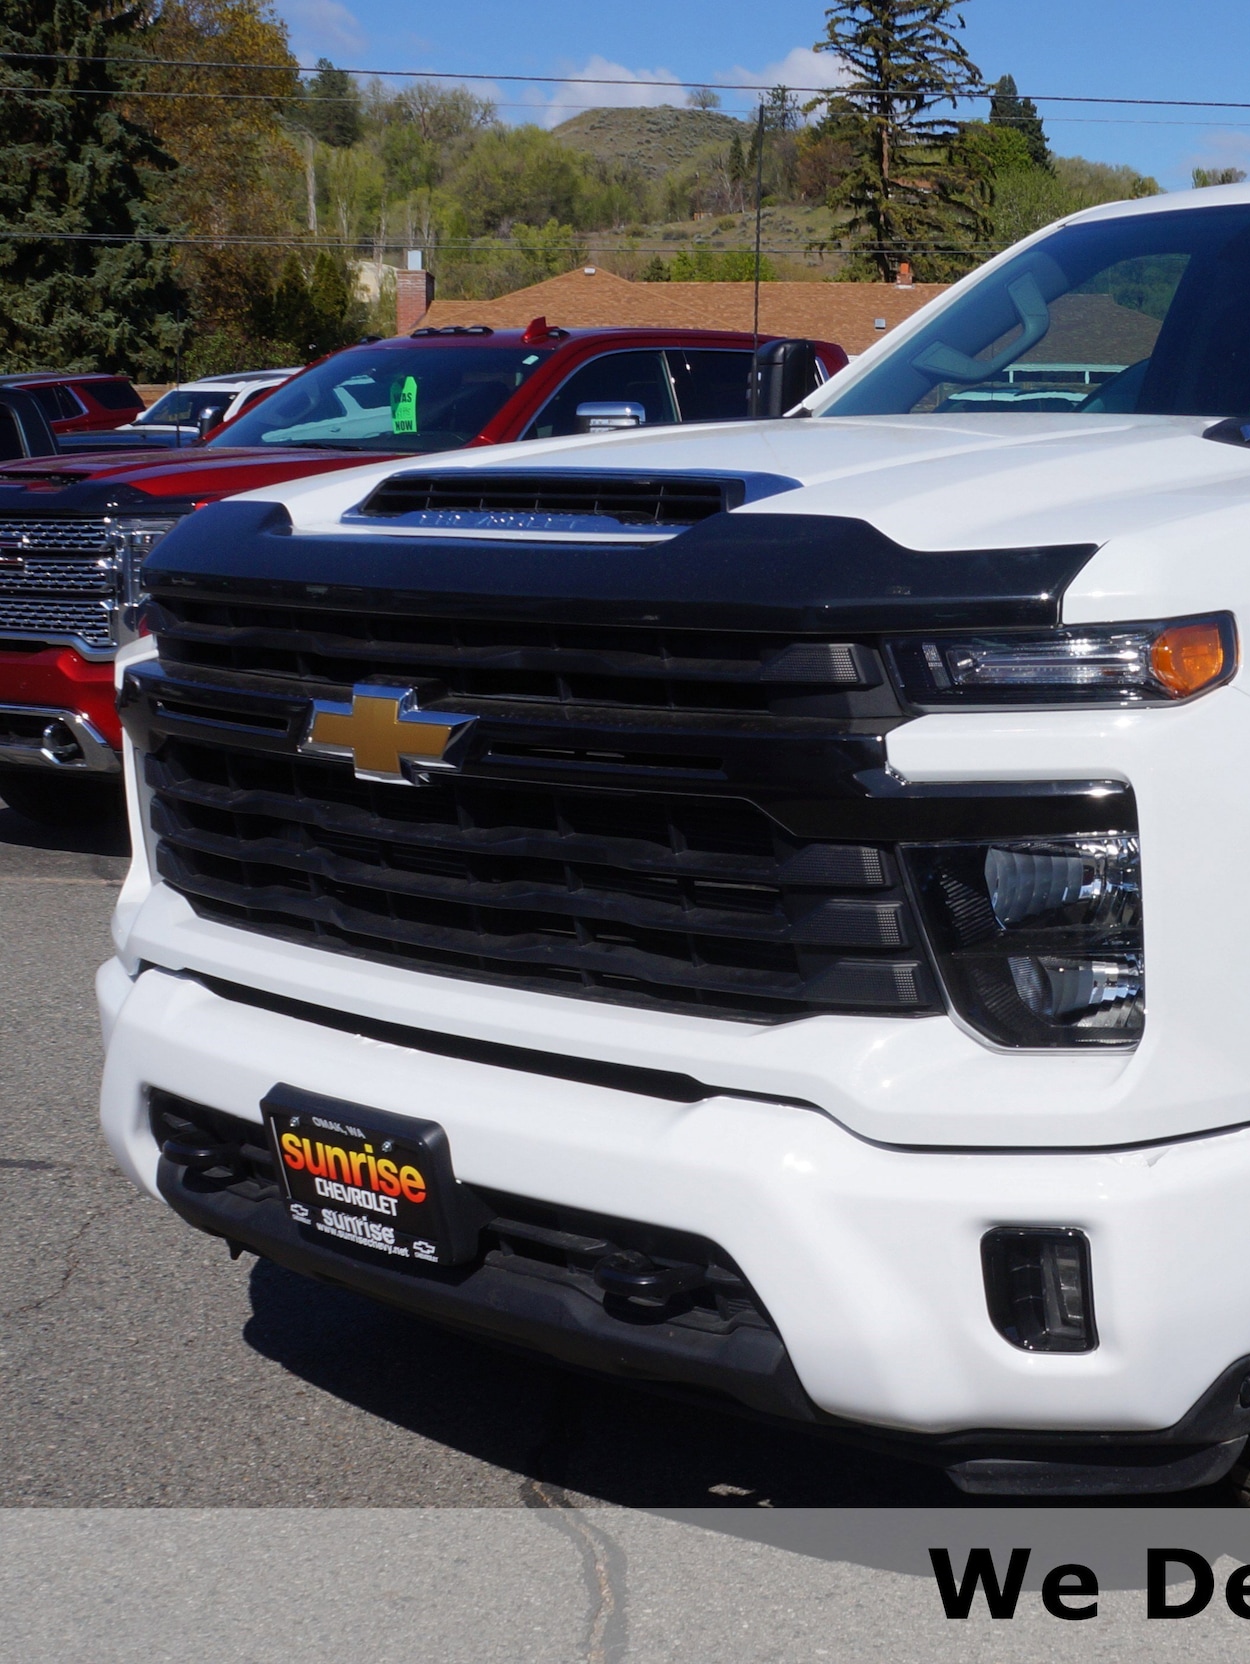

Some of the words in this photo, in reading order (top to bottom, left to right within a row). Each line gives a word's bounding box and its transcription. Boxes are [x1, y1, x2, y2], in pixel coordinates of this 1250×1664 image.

[395, 420, 413, 431] NOW
[311, 1116, 347, 1134] OMAK,
[346, 1124, 366, 1139] WA
[281, 1132, 427, 1204] sunrise
[314, 1177, 399, 1217] CHEVROLET
